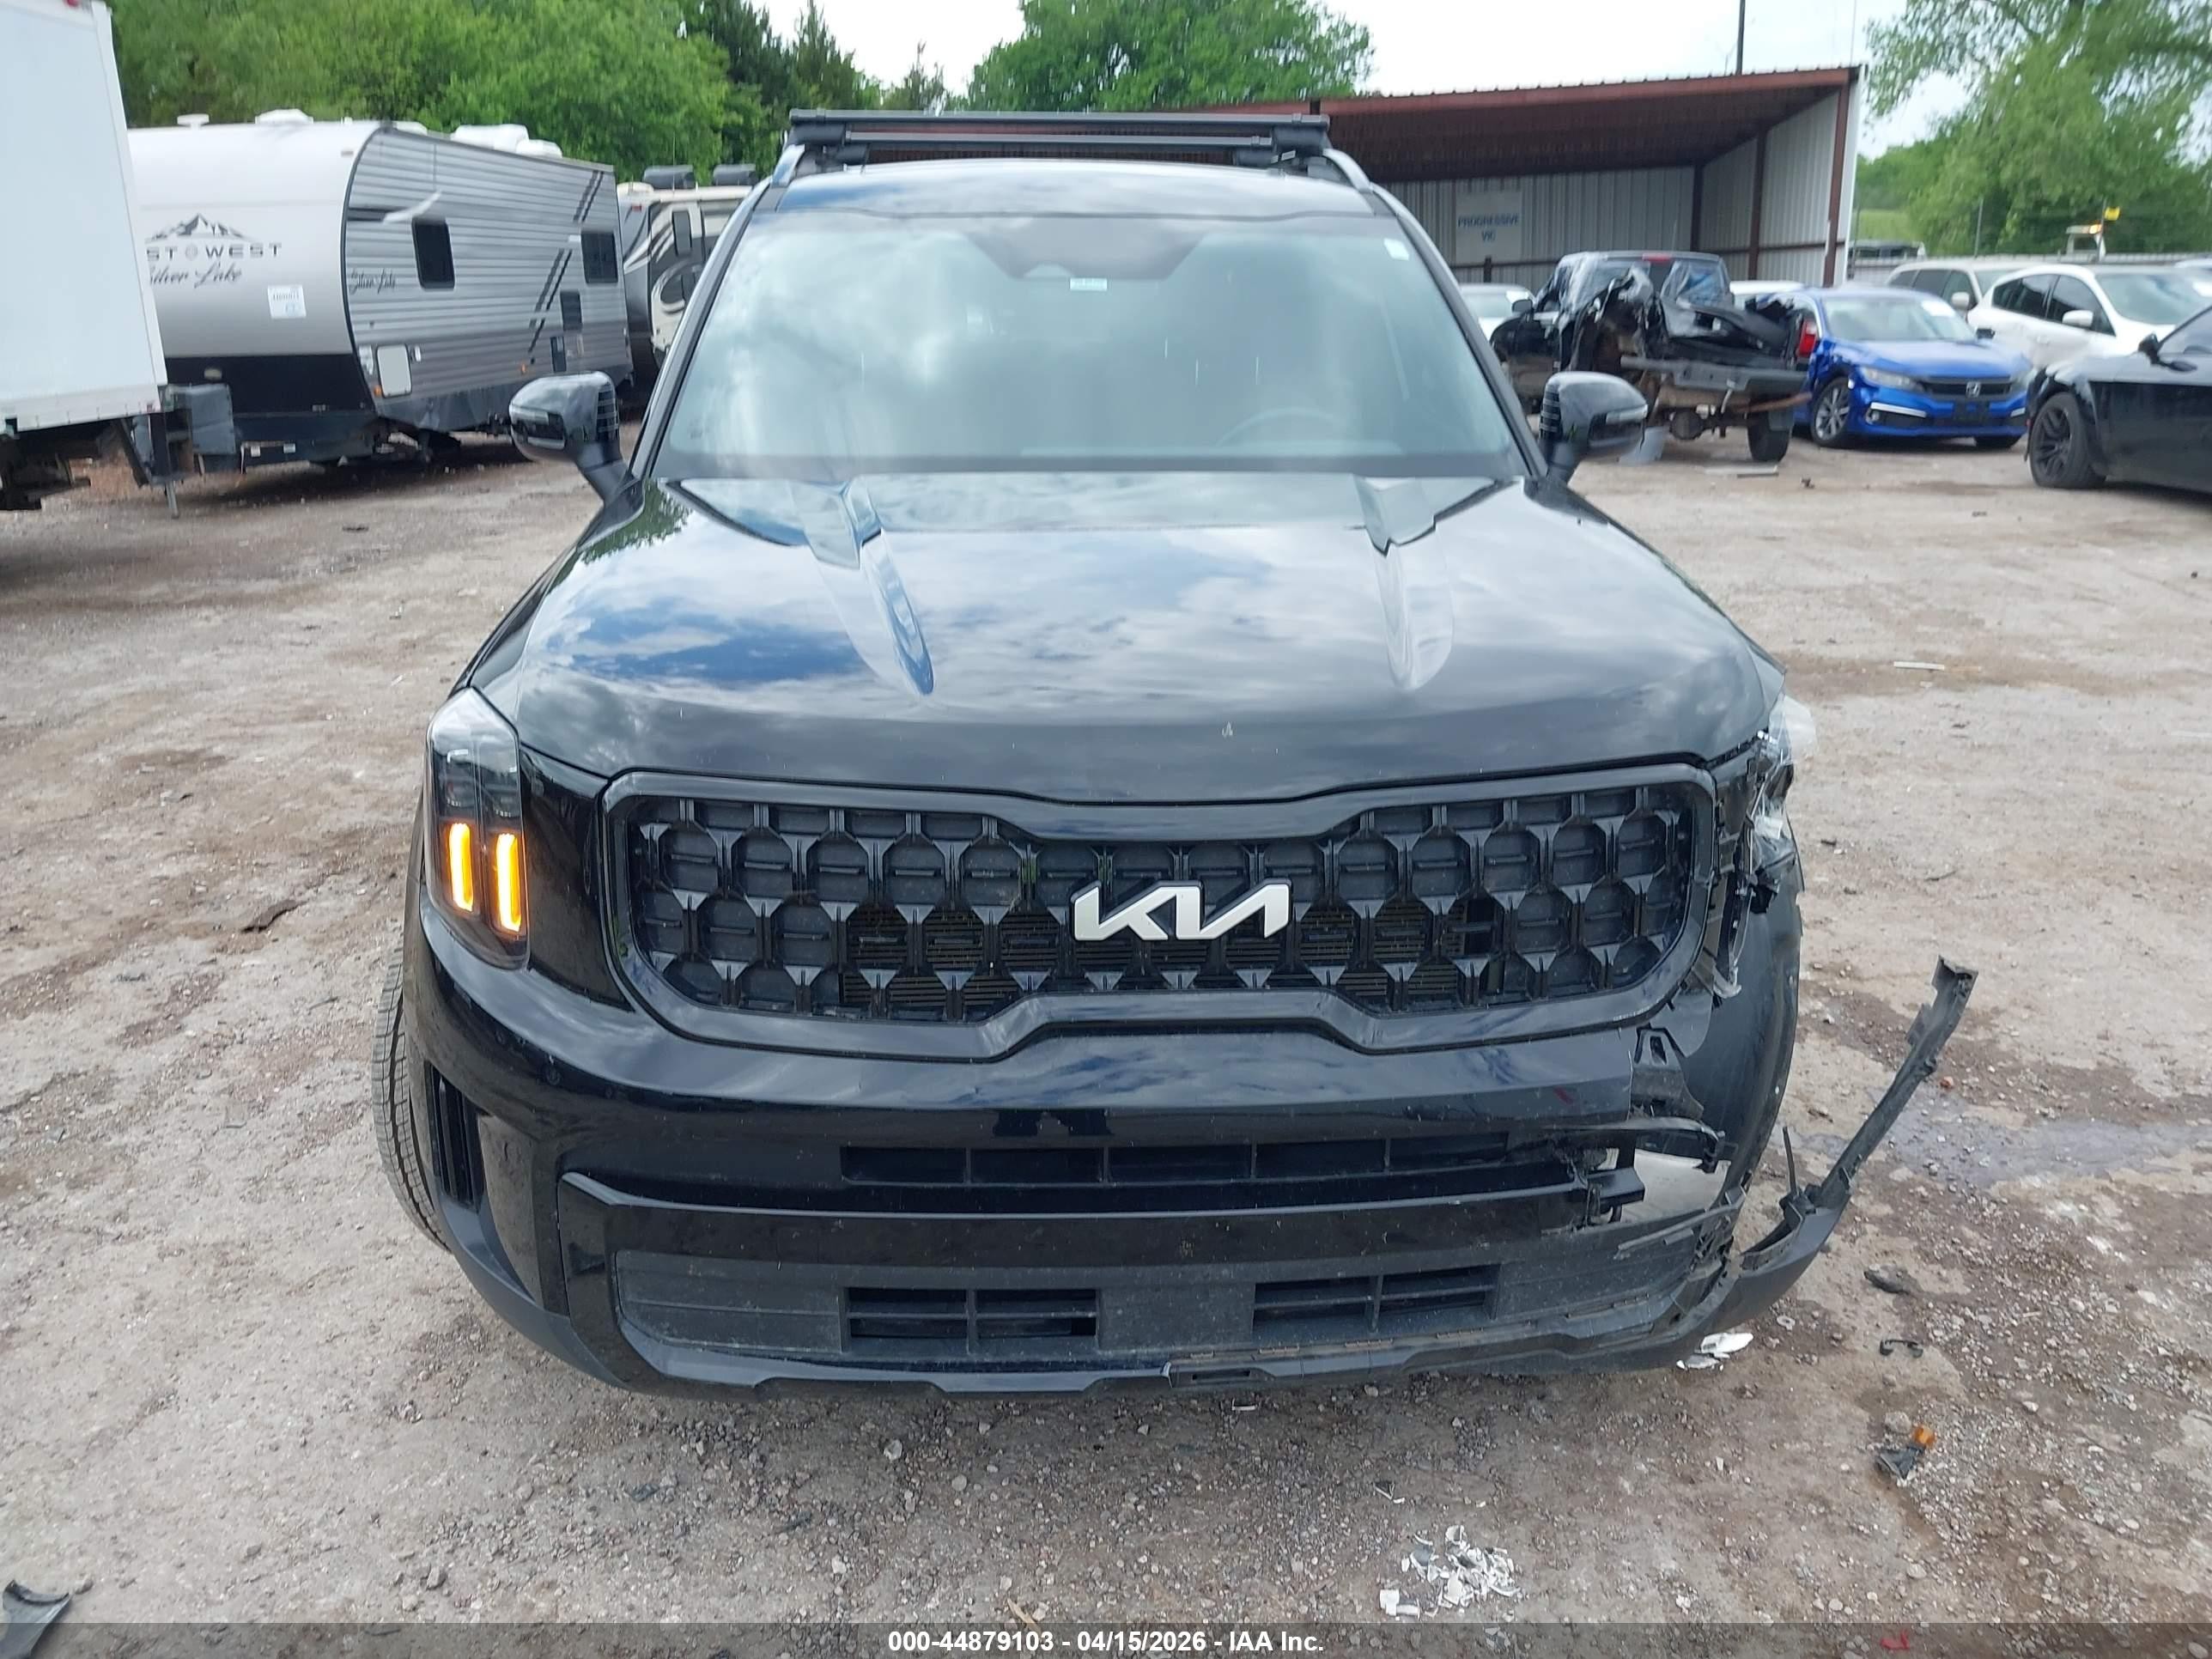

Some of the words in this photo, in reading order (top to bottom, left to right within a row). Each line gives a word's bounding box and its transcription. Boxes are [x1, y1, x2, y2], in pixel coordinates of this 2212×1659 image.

[1457, 215, 1519, 228] PROGRESSIVE
[147, 245, 178, 261] ST
[205, 242, 282, 258] WEST
[1071, 881, 1291, 941] KIA
